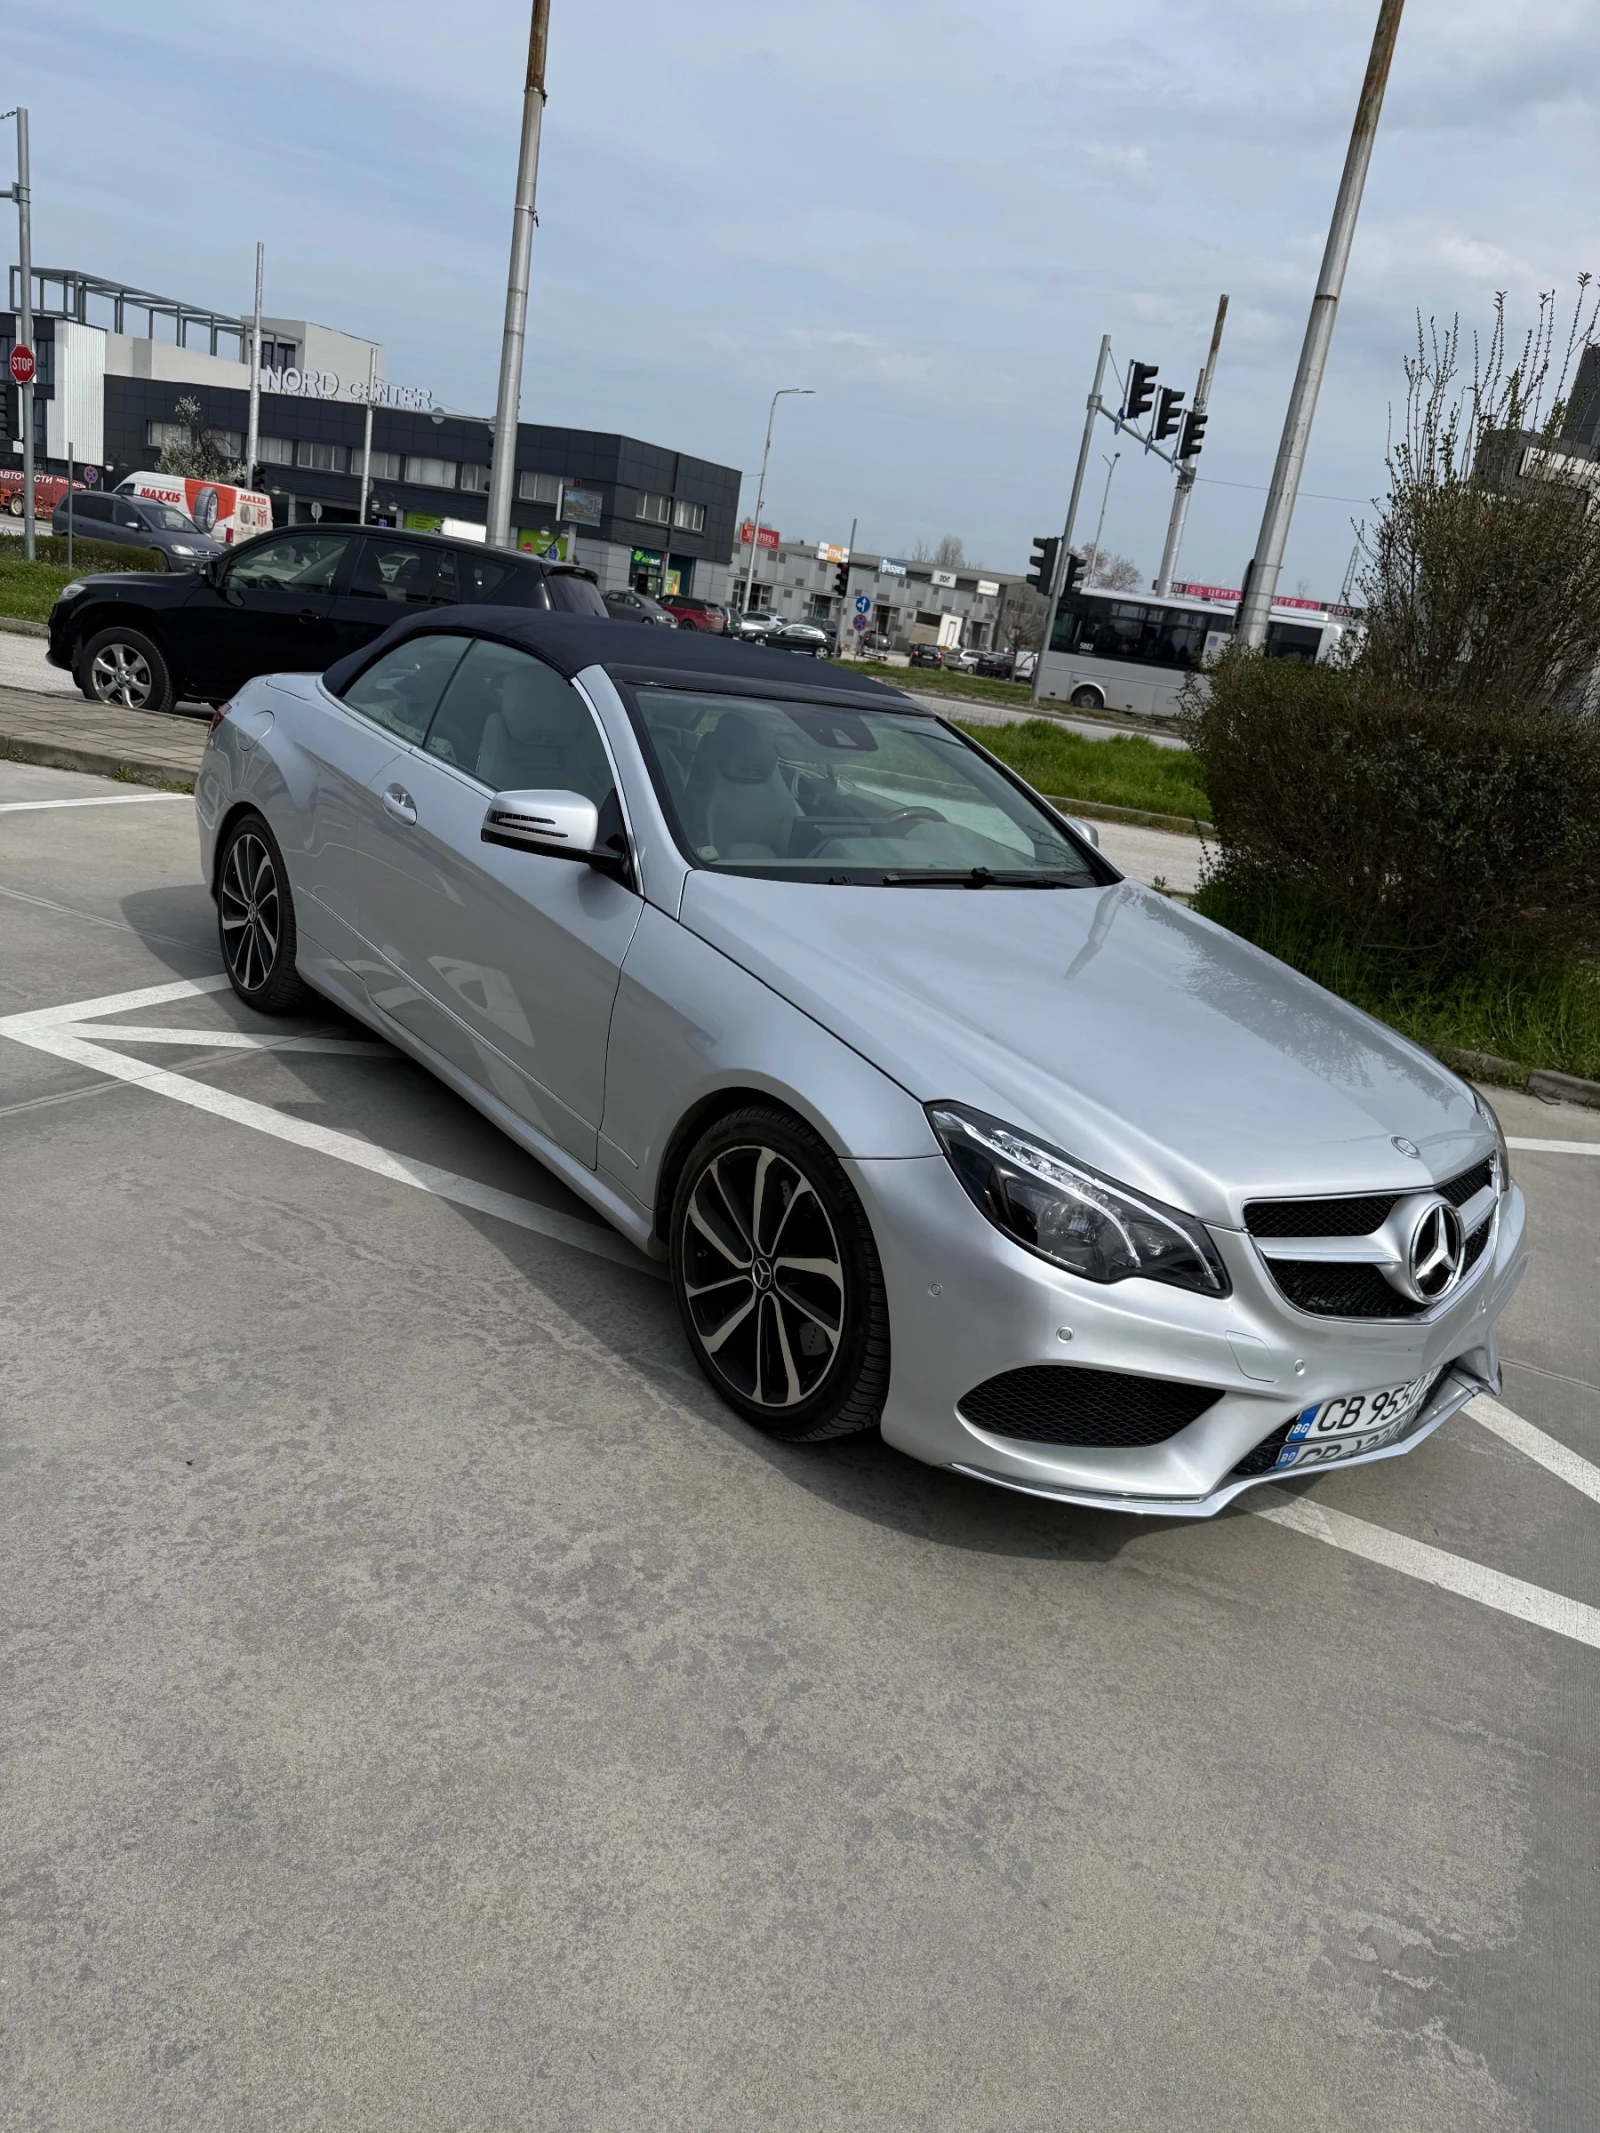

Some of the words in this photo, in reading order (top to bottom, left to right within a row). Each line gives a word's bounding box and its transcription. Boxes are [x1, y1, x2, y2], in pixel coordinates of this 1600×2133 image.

[12, 356, 33, 372] STOP
[266, 365, 339, 397] NORD
[0, 470, 53, 484] АВТОСТИ
[140, 487, 181, 503] MAXXIS
[240, 494, 267, 506] MAXXIS
[1207, 588, 1242, 600] ЦЕНТЪ
[1293, 1423, 1310, 1434] BG
[1318, 1396, 1366, 1432] CB
